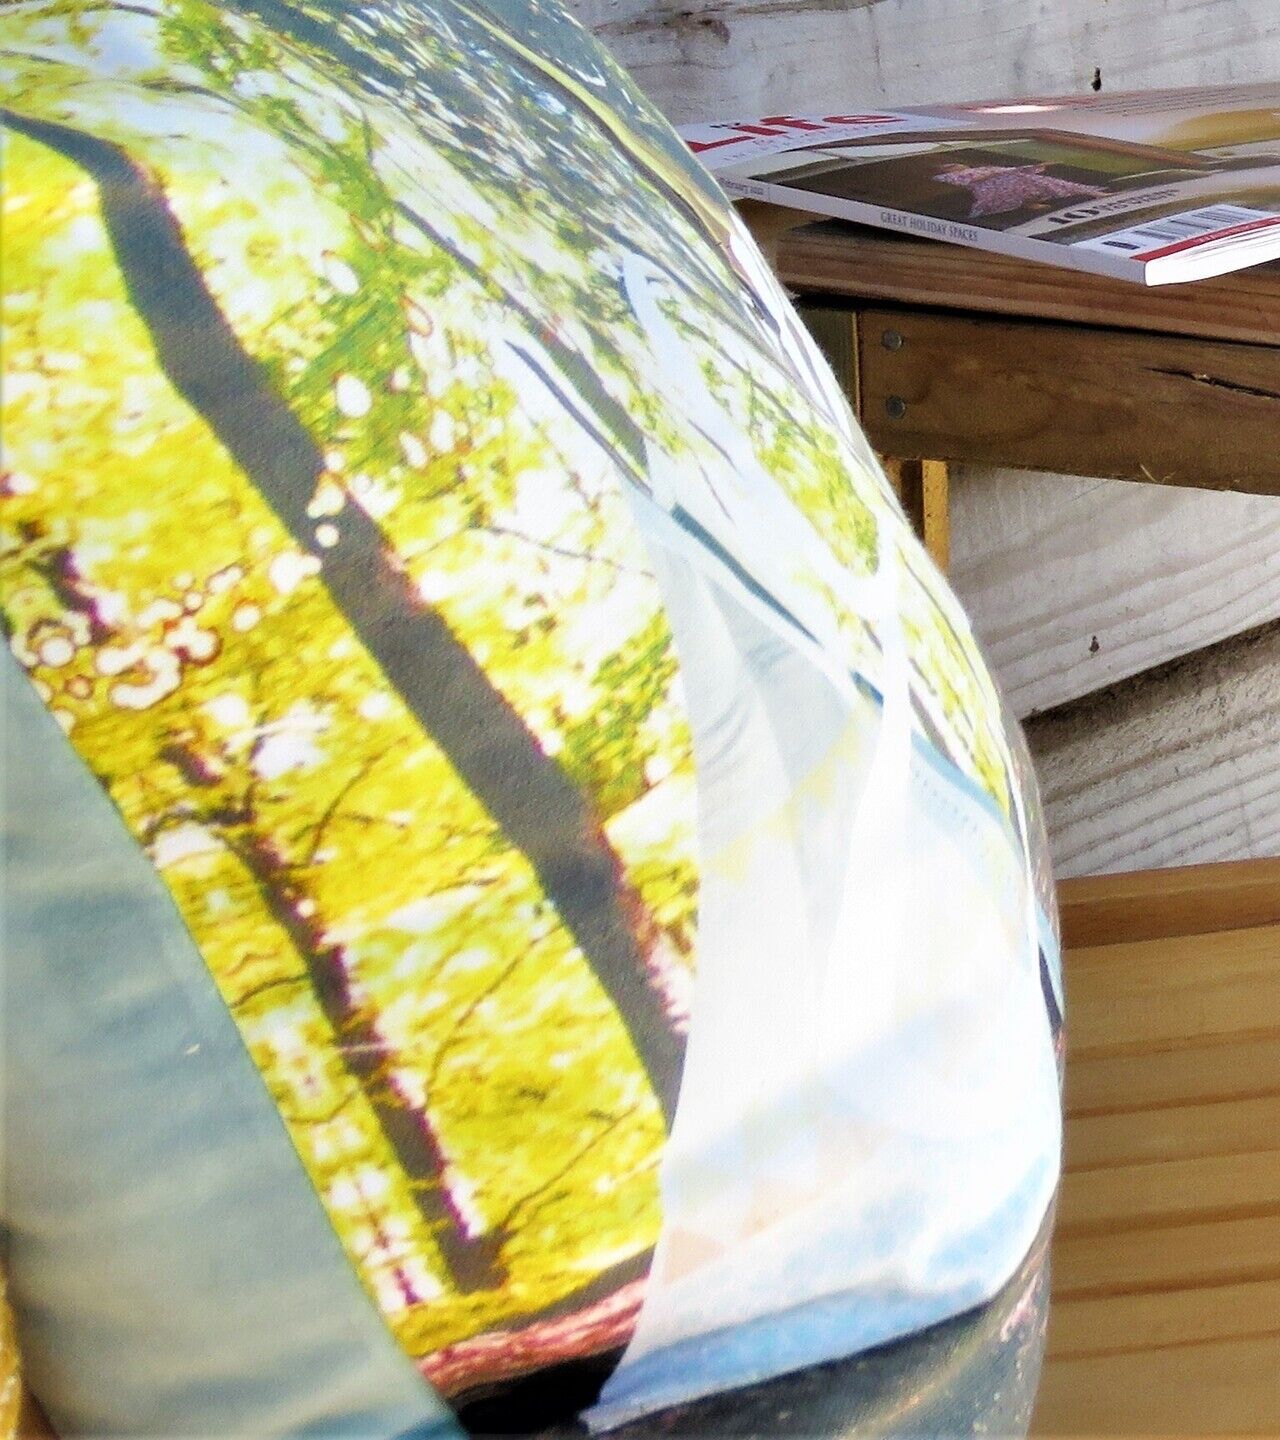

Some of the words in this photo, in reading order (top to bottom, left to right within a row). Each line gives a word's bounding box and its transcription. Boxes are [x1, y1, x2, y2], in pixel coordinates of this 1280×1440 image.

[880, 211, 907, 227] GREAT
[909, 217, 947, 235] HOLIDAY
[948, 225, 979, 242] SPACES
